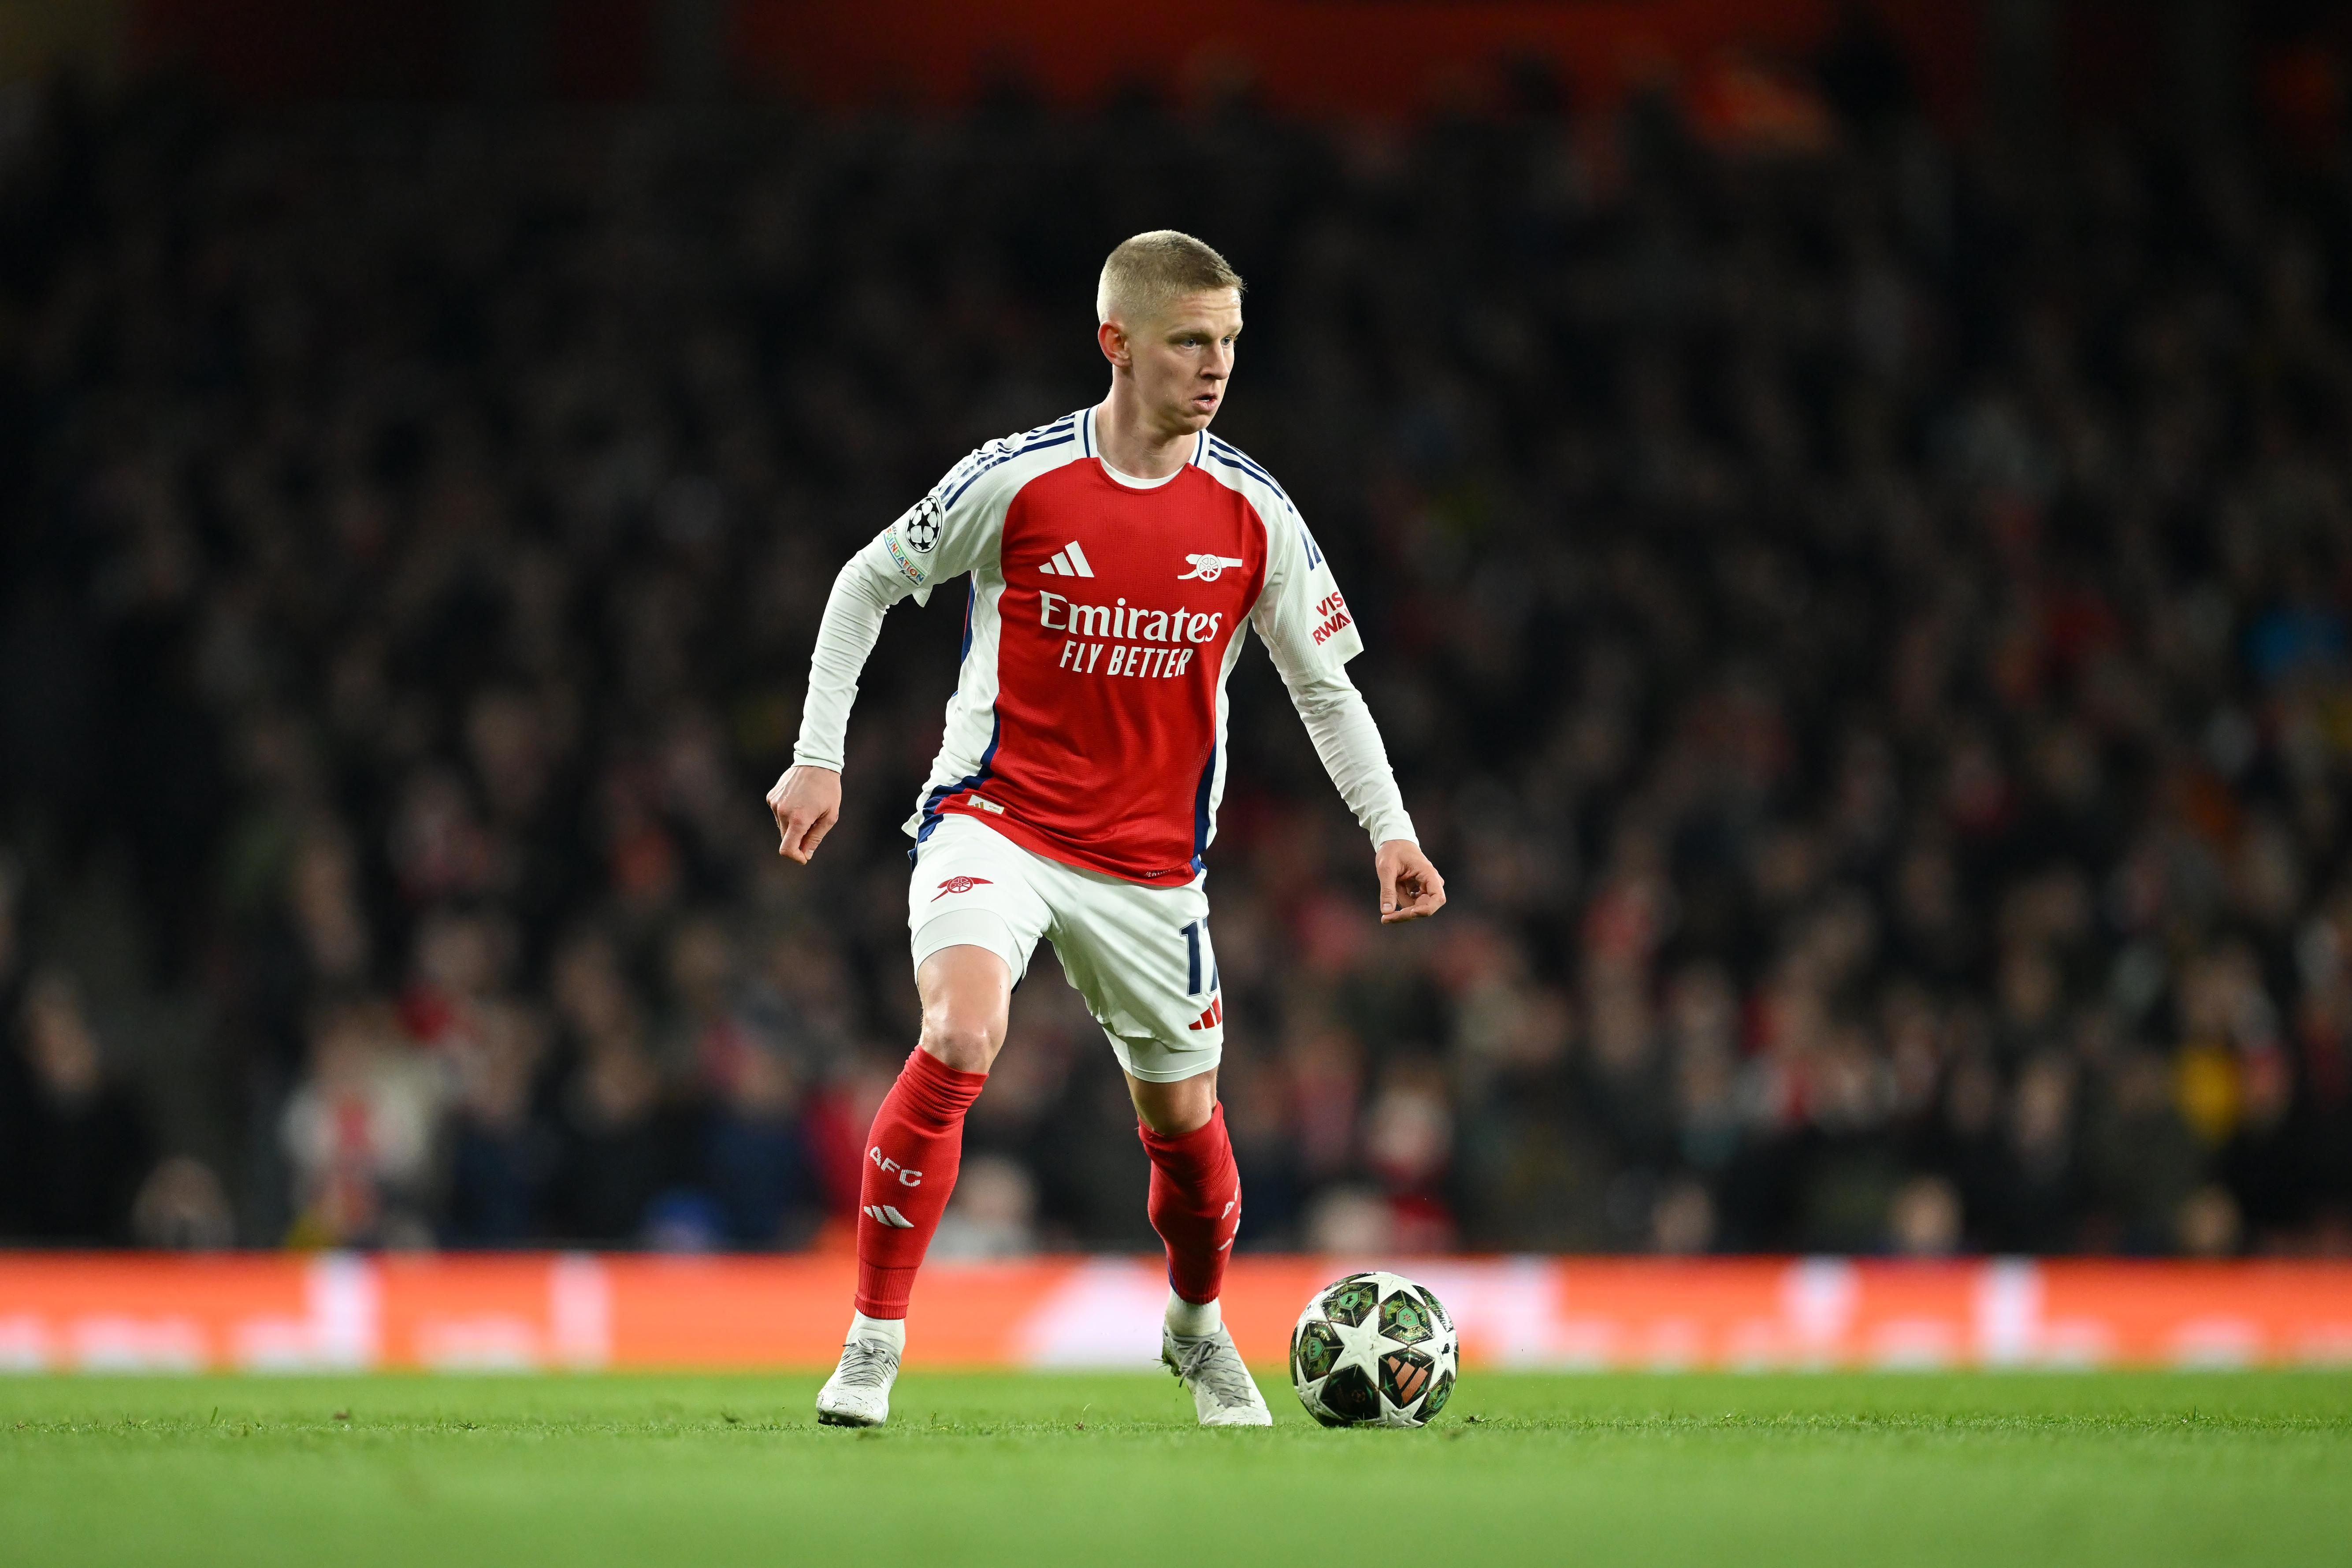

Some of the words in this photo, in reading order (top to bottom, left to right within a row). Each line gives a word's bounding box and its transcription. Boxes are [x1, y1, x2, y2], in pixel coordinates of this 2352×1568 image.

[1039, 590, 1222, 643] Emirates
[1059, 640, 1104, 673] FLY
[1107, 645, 1193, 678] BETTER
[869, 1146, 922, 1187] AFC
